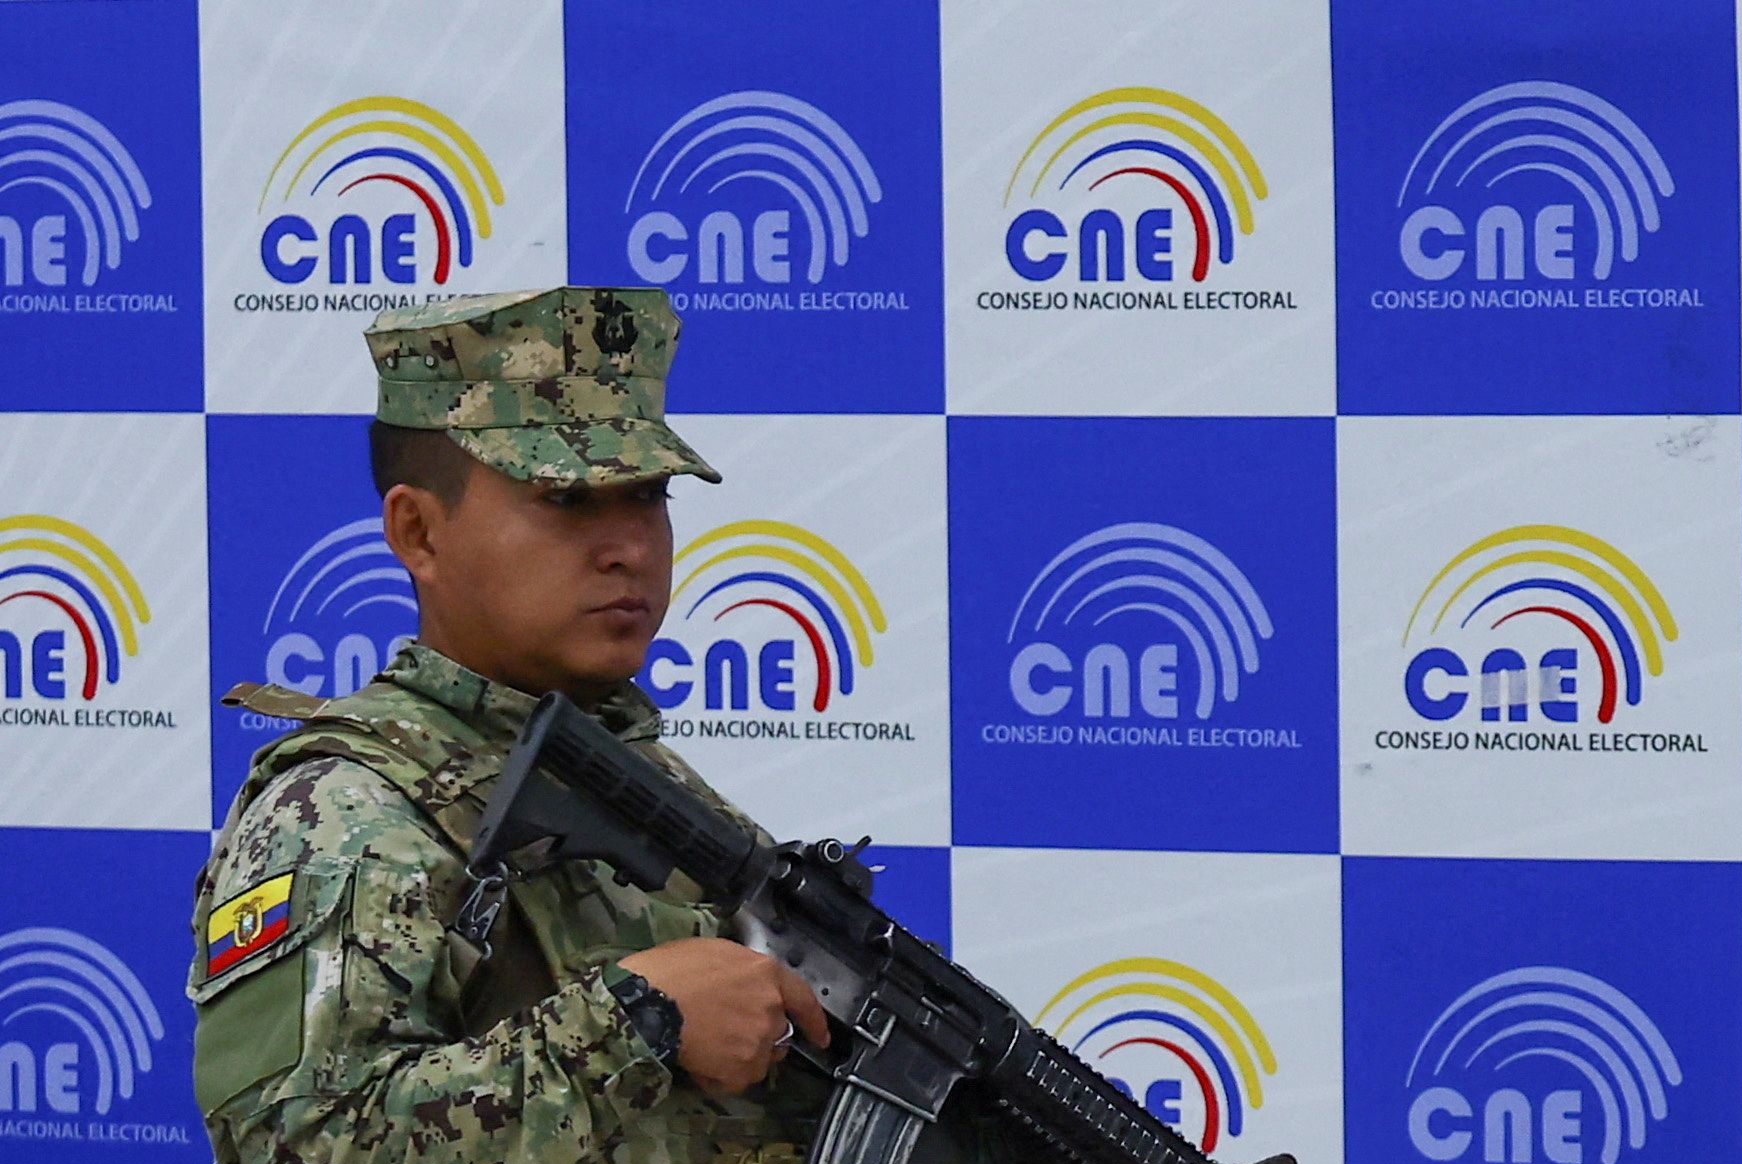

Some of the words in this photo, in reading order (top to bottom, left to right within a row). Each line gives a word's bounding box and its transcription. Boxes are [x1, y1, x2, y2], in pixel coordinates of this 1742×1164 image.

[0, 215, 67, 287] NE
[260, 213, 417, 285] CNE
[626, 210, 791, 285] CNE
[1005, 207, 1174, 283] CNE
[1399, 204, 1575, 281] CNE
[0, 294, 71, 313] CIONAL
[75, 294, 178, 313] ELECTORAL
[234, 294, 319, 312] CONSEJO
[693, 292, 795, 311] NACIONAL
[799, 291, 910, 311] ELECTORAL
[977, 291, 1068, 310] CONSEJO
[1074, 291, 1178, 310] NACIONAL
[1183, 291, 1298, 310] ELECTORAL
[1370, 290, 1466, 310] CONSEJO
[1470, 289, 1580, 309] NACIONAL
[1584, 288, 1704, 308] ELECTORAL
[264, 632, 410, 699] CN
[635, 637, 796, 712] CNE
[1009, 642, 1179, 719] CNE
[0, 708, 69, 727] CIONAL
[74, 709, 176, 728] ELECTORAL
[240, 711, 302, 732] CONS
[699, 720, 800, 739] NACIONAL
[805, 721, 914, 741] ELECTORAL
[982, 724, 1074, 744] CONSEJO
[1078, 726, 1183, 746] NACIONAL
[1187, 728, 1302, 748] ELECTORAL
[1375, 730, 1470, 750] CONSEJO
[1475, 732, 1583, 751] NACIONAL
[1589, 733, 1708, 753] ELECTORAL
[0, 1041, 80, 1113] NE
[0, 1119, 82, 1140] ACIONAL
[88, 1122, 190, 1144] ELECTORAL
[1407, 1086, 1583, 1164] CNE
